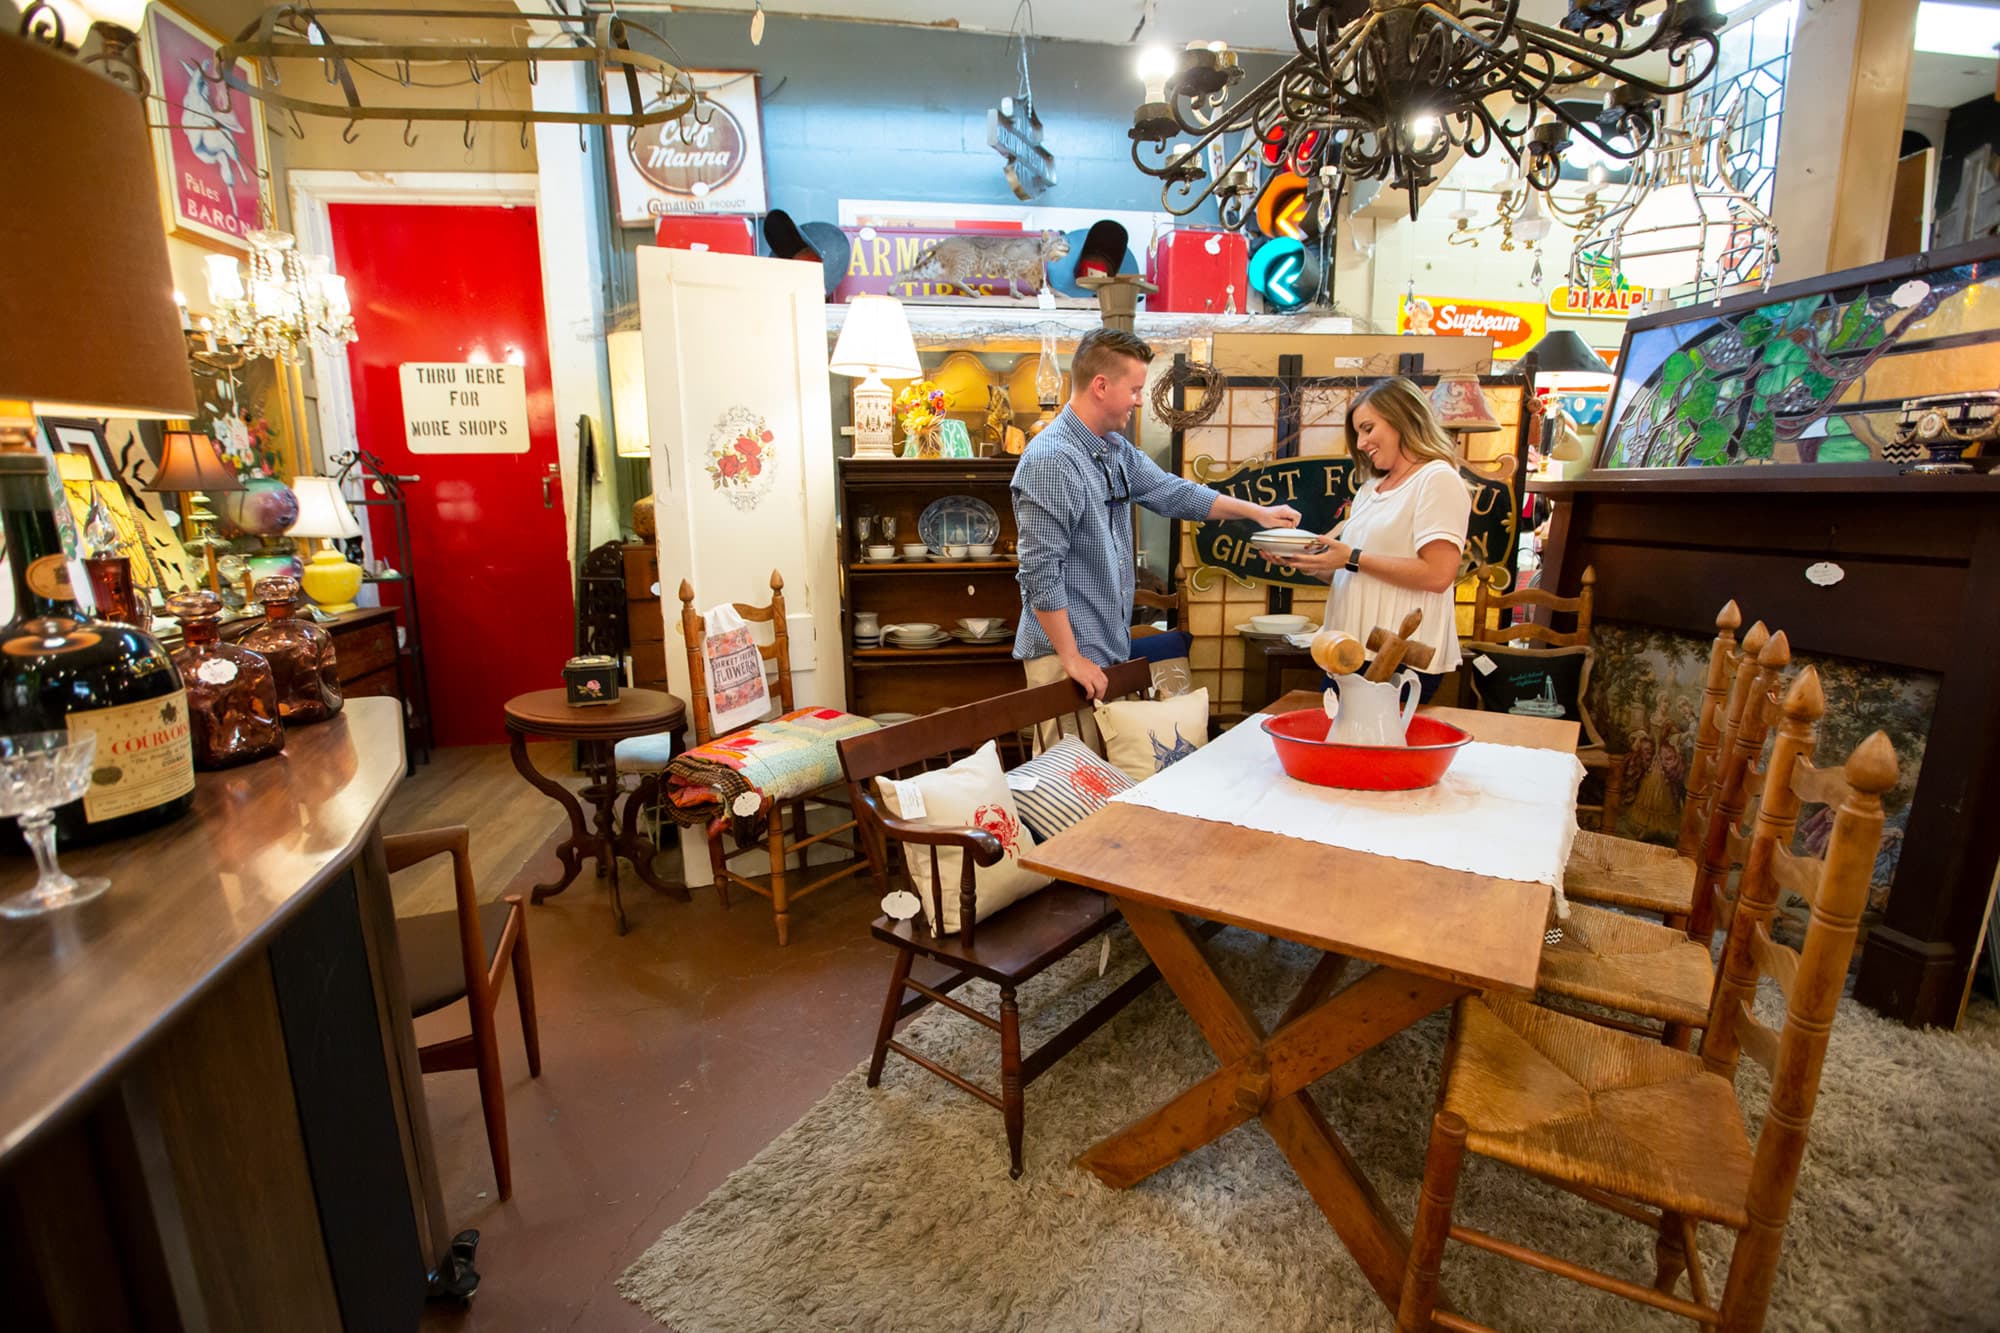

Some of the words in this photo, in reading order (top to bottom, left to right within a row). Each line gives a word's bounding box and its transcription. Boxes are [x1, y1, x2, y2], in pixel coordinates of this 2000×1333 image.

[648, 145, 731, 169] Manna
[648, 198, 704, 216] Carnation
[710, 199, 746, 210] PRODUCT
[1436, 305, 1520, 332] Sunbeam
[416, 367, 457, 385] THRU
[465, 367, 506, 385] HERE
[449, 390, 480, 407] FOR
[411, 421, 452, 437] MORE
[459, 420, 508, 436] SHOPS
